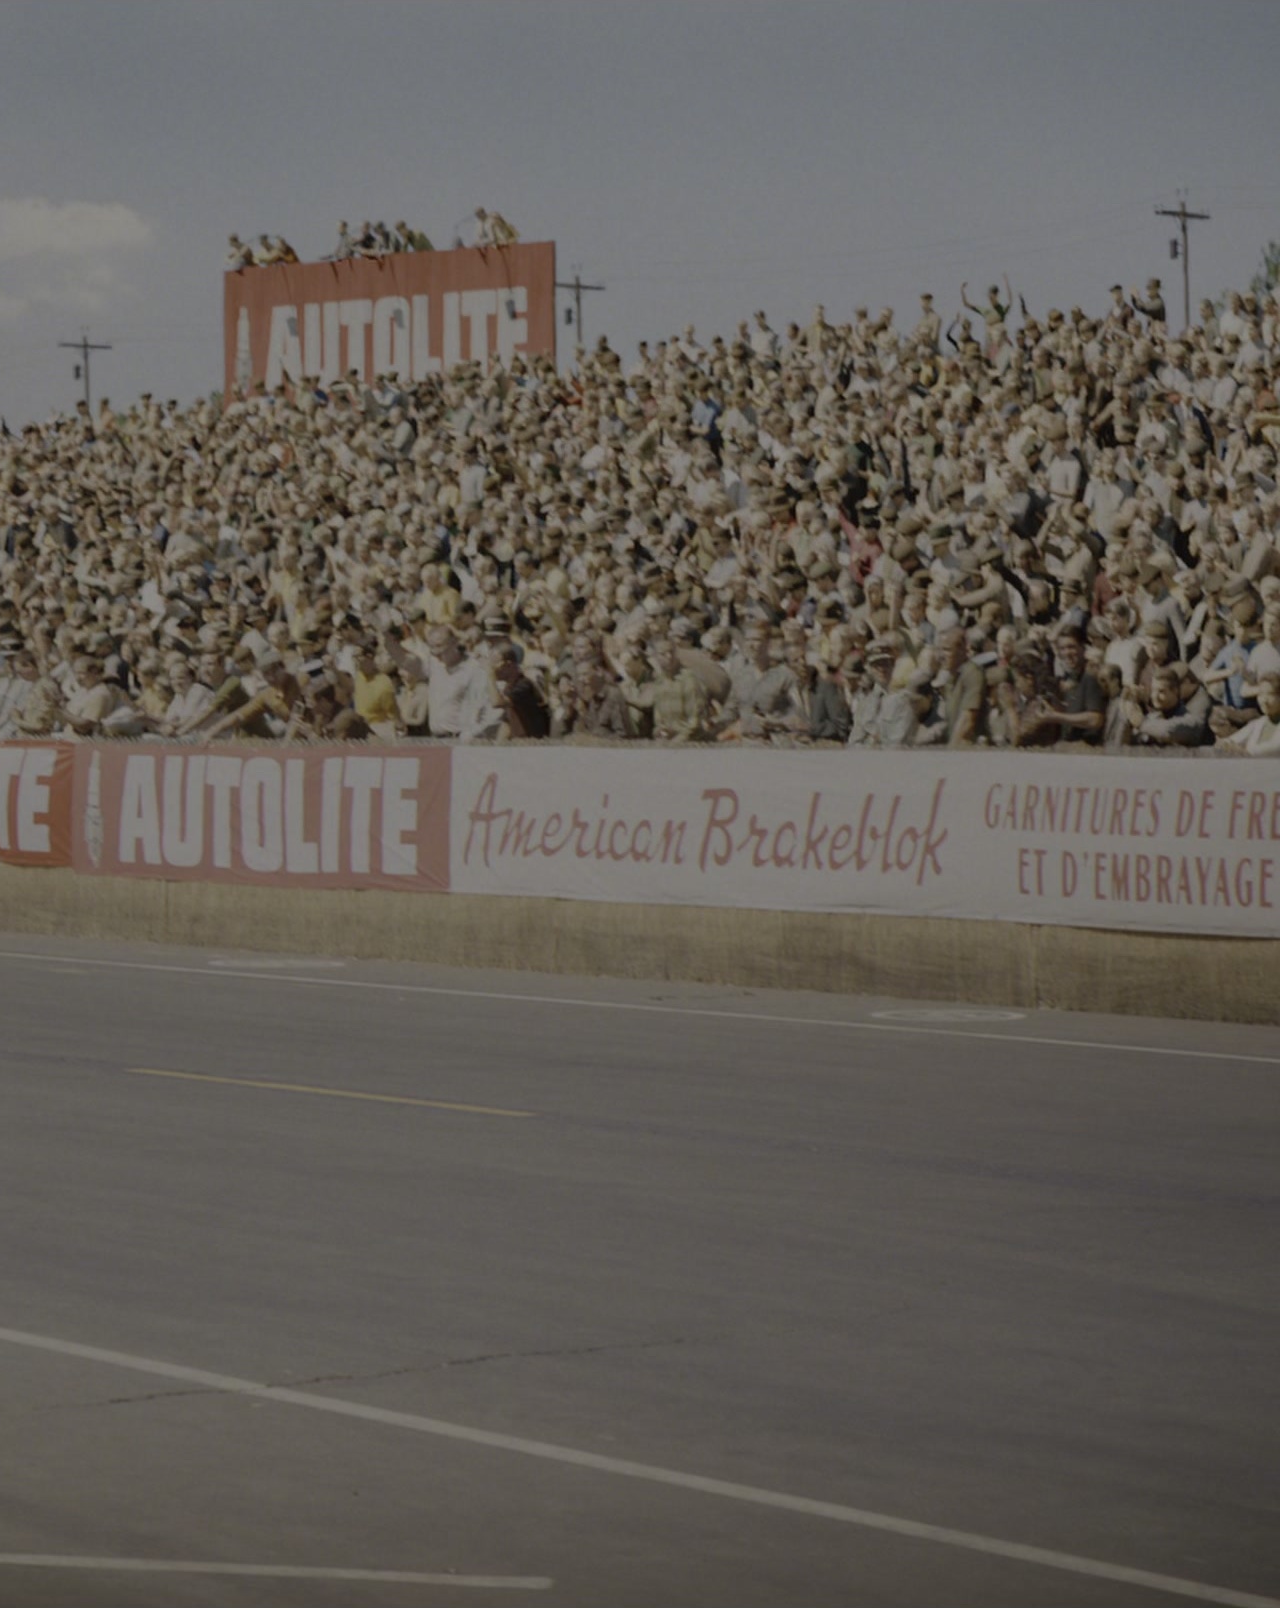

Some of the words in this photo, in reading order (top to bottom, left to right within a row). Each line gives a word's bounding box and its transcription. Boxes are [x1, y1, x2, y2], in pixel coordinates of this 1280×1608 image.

[264, 286, 528, 393] AUTOLITE
[118, 753, 420, 876] AUTOLITE
[462, 772, 688, 868] American
[699, 777, 949, 886] Brakeblok
[984, 782, 1163, 838] GARNITURES
[1175, 789, 1215, 838] DE
[1018, 848, 1047, 896] ET
[1061, 850, 1274, 908] D'EMBRAYAGE
